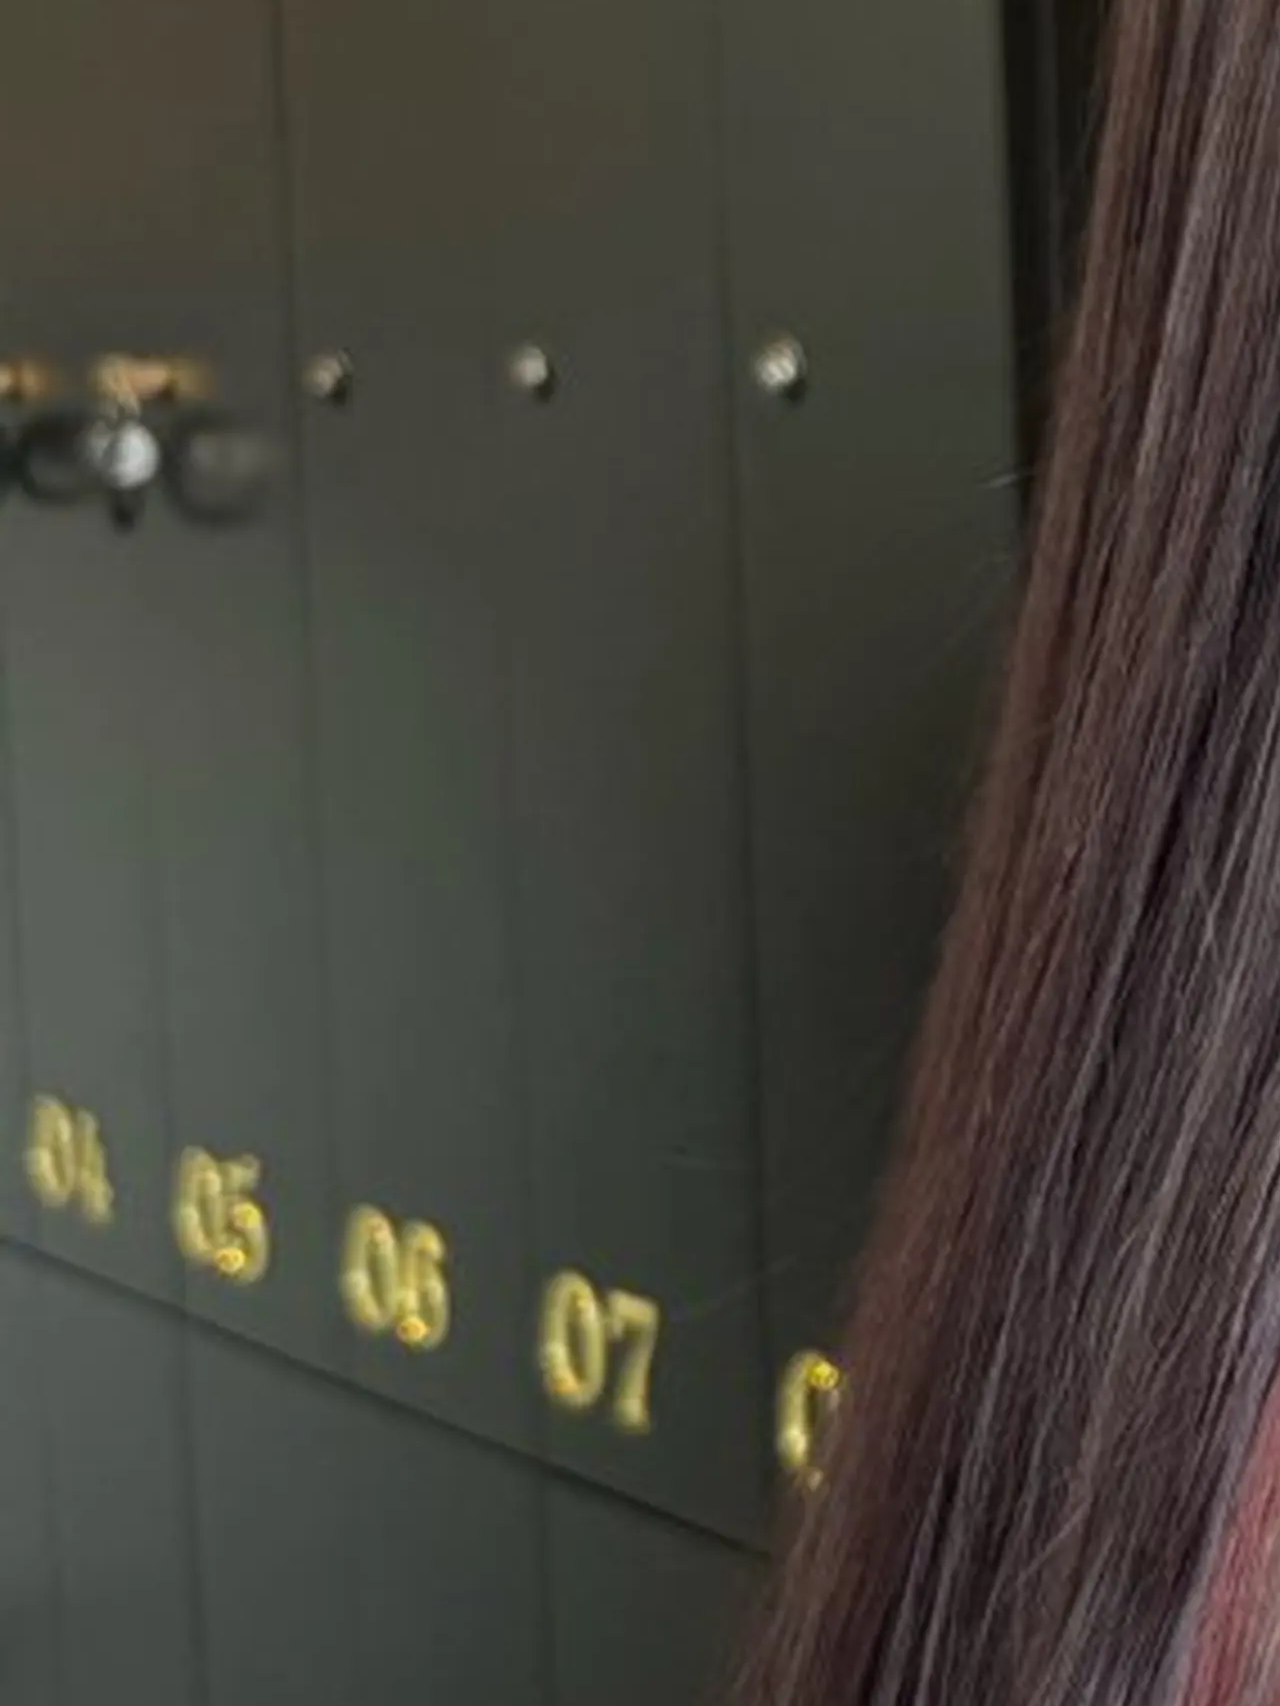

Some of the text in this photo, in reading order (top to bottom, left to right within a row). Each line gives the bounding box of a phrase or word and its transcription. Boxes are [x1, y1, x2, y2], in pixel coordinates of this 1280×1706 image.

[26, 1093, 114, 1224] 04
[173, 1143, 270, 1286] 05
[341, 1203, 449, 1349] 06
[539, 1268, 660, 1428] 07
[776, 1349, 842, 1488] 0
